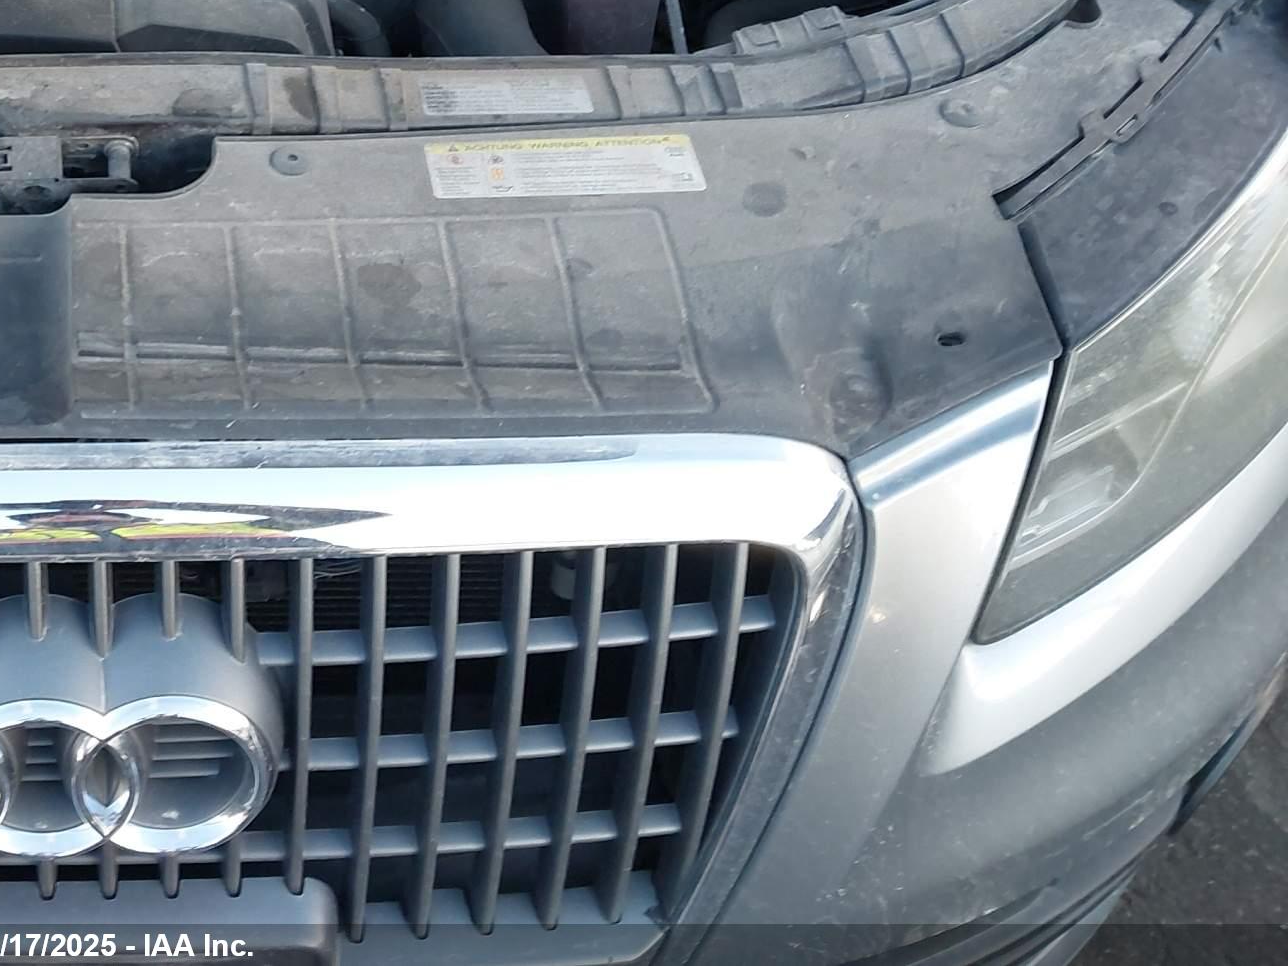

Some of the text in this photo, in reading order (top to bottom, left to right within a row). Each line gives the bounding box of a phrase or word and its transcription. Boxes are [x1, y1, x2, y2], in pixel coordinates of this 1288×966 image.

[463, 137, 663, 152] ACHTUNG WARNING ATTENTION
